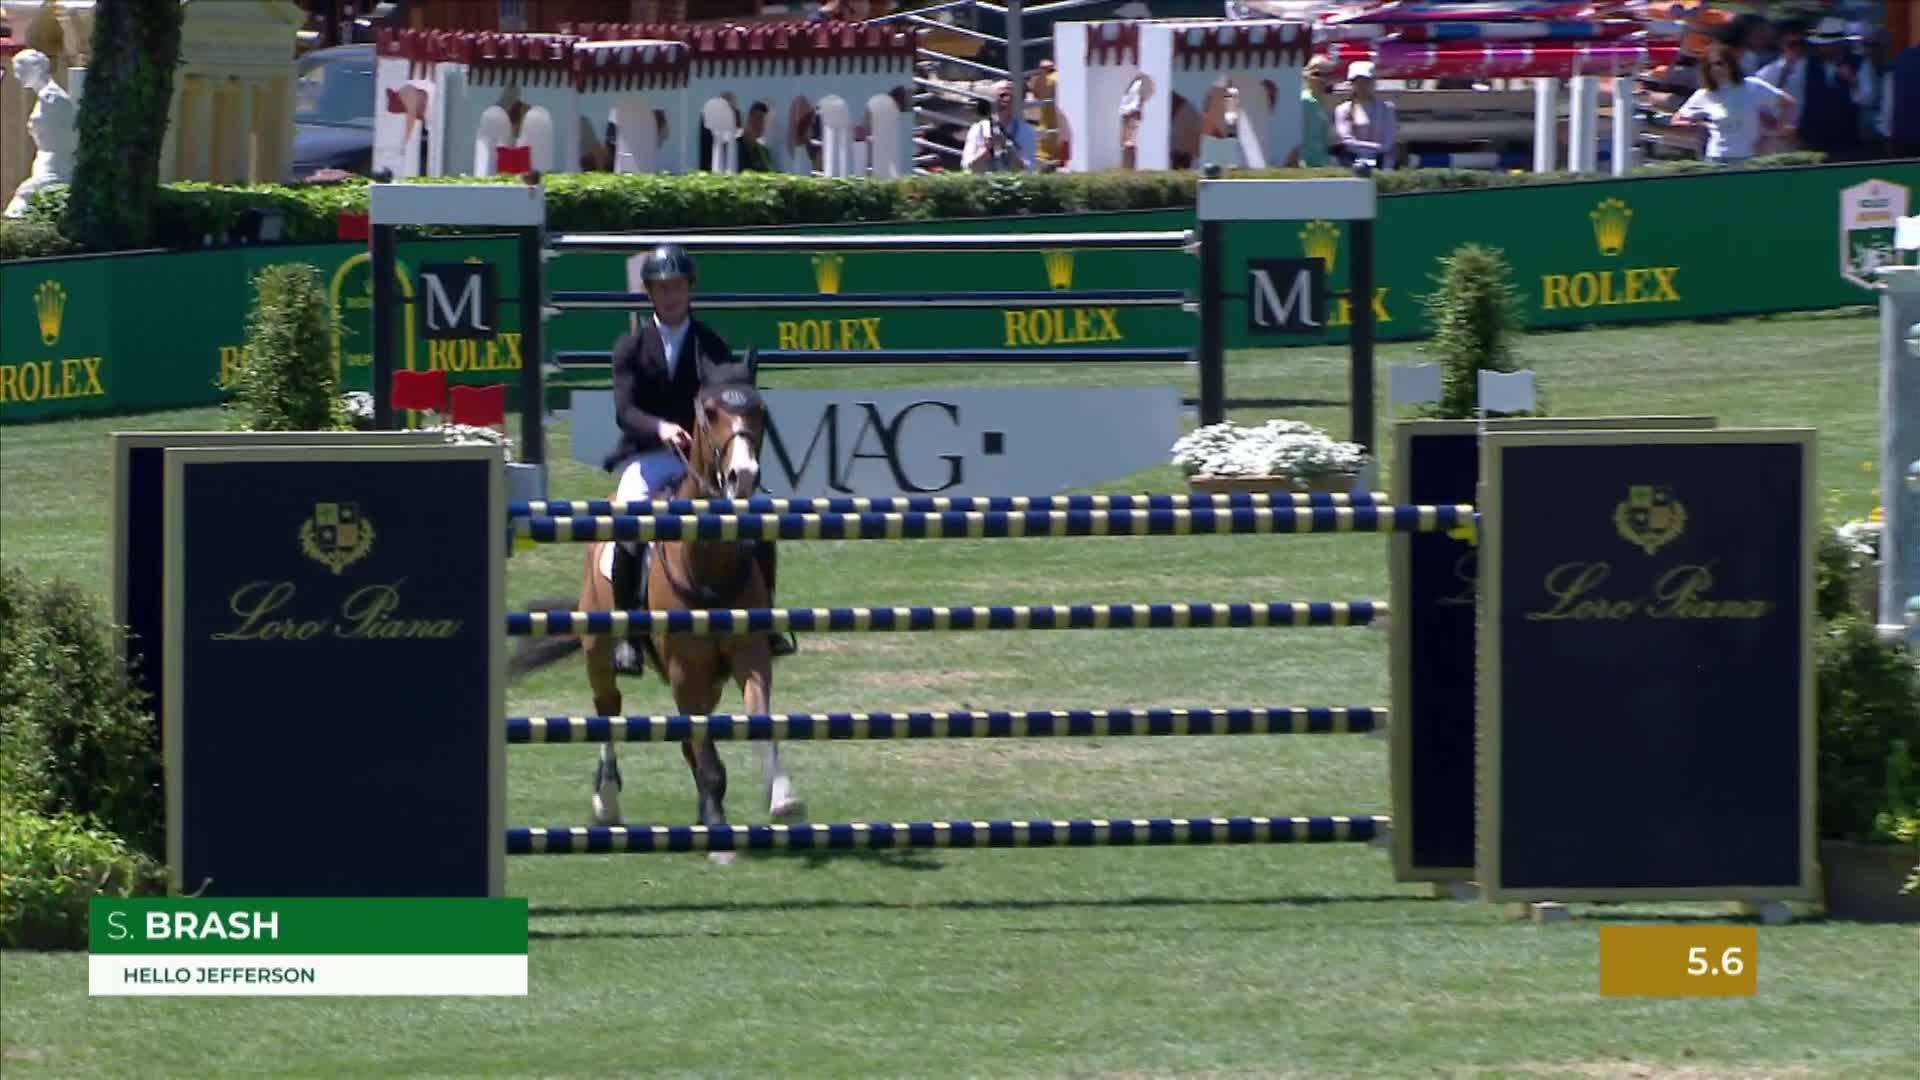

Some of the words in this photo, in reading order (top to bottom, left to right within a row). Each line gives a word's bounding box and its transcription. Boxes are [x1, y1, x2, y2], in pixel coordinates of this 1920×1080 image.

[421, 272, 491, 331] M
[1249, 269, 1321, 327] M
[1542, 266, 1682, 310] ROLEX
[778, 317, 882, 351] ROLEX
[1004, 307, 1123, 346] ROLEX
[428, 333, 523, 372] ROLEX
[0, 357, 104, 403] ROLEX
[209, 581, 327, 640] Loro
[335, 576, 463, 639] Piana
[1525, 561, 1636, 620] Loro
[1646, 557, 1773, 619] Piana
